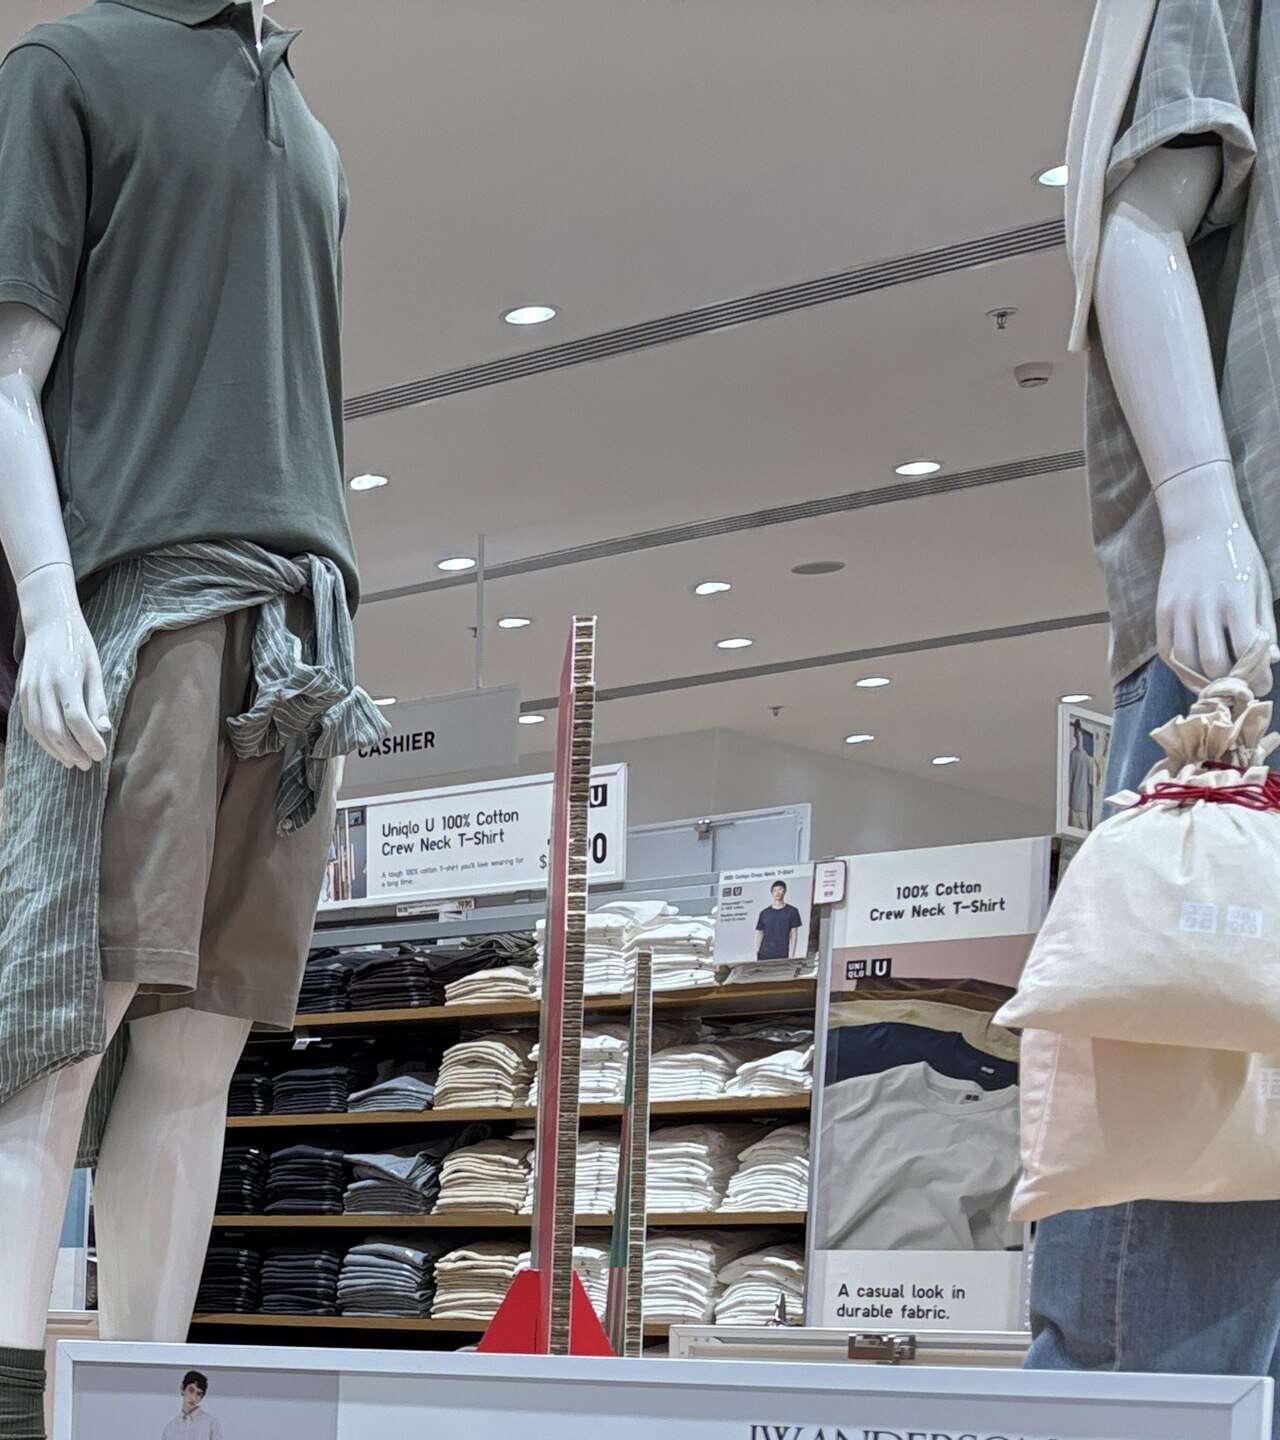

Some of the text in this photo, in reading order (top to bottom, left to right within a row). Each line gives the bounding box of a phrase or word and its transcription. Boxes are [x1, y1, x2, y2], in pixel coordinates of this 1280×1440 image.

[382, 807, 519, 843] Uniqlo U 100% Cotton
[382, 829, 505, 856] Crew Neck T-Shirt
[896, 881, 982, 900] 100% Cotton
[870, 897, 1006, 921] Crew Neck T-Shirt
[875, 961, 887, 977] U
[837, 1283, 966, 1299] A casual look in
[836, 1303, 951, 1320] durable fabric.
